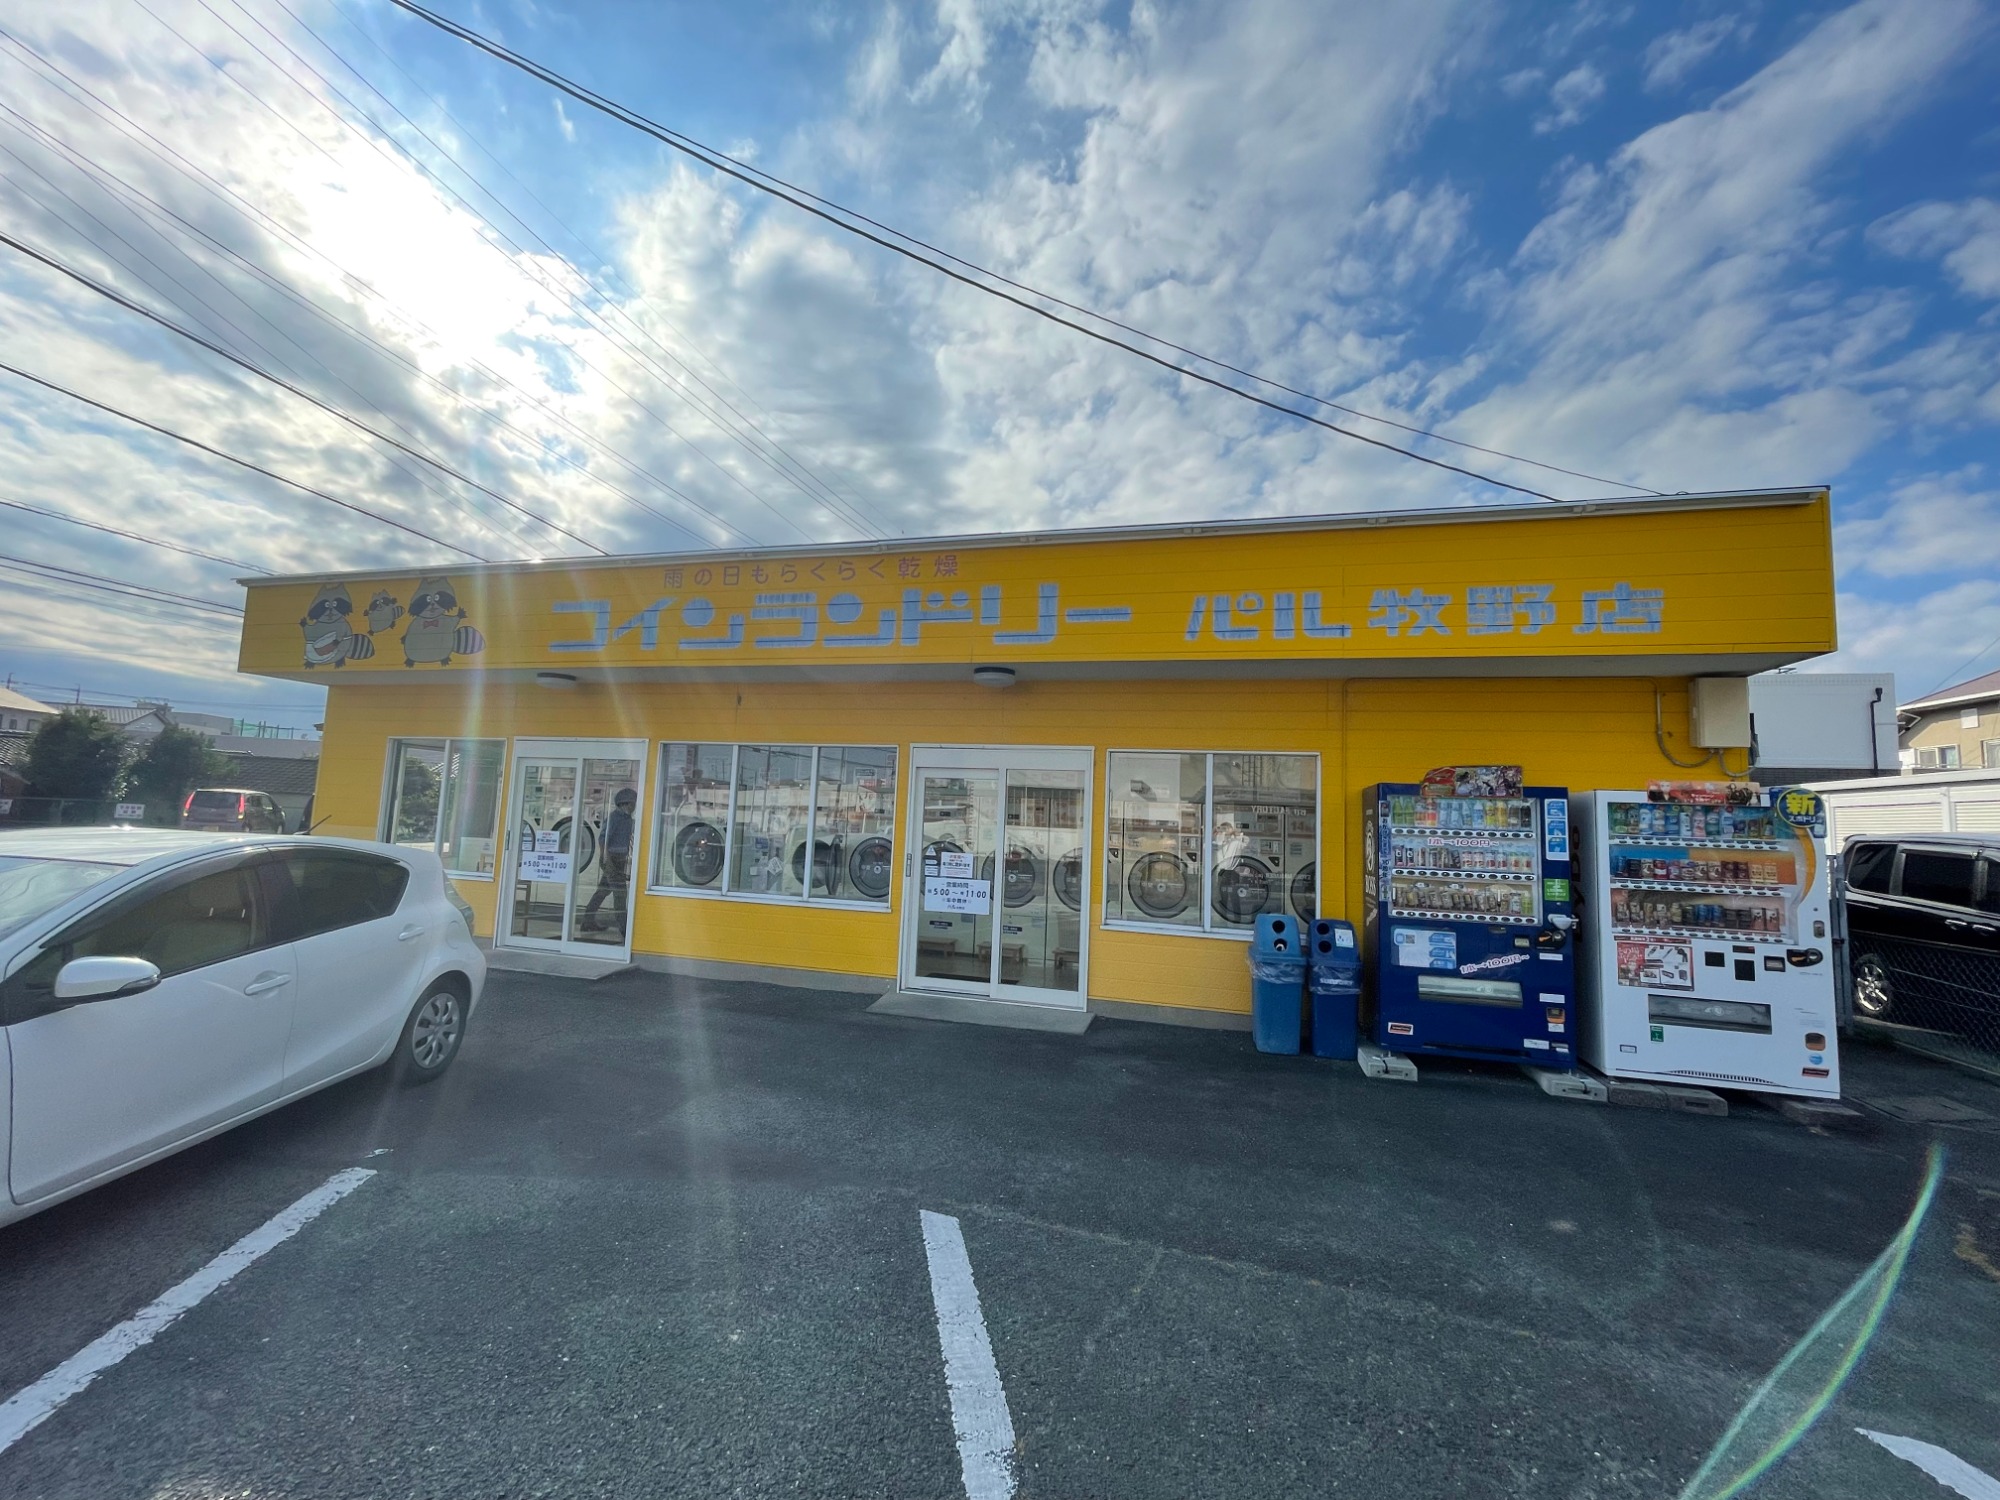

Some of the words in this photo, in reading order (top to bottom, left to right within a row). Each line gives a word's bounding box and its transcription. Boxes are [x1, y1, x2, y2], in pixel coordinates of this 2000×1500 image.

[663, 555, 958, 589] 雨の日もらくらく乾燥
[549, 582, 1132, 652] コインランドリー
[1185, 591, 1352, 641] パル
[1368, 582, 1664, 637] 牧野店
[1786, 793, 1816, 815] 新
